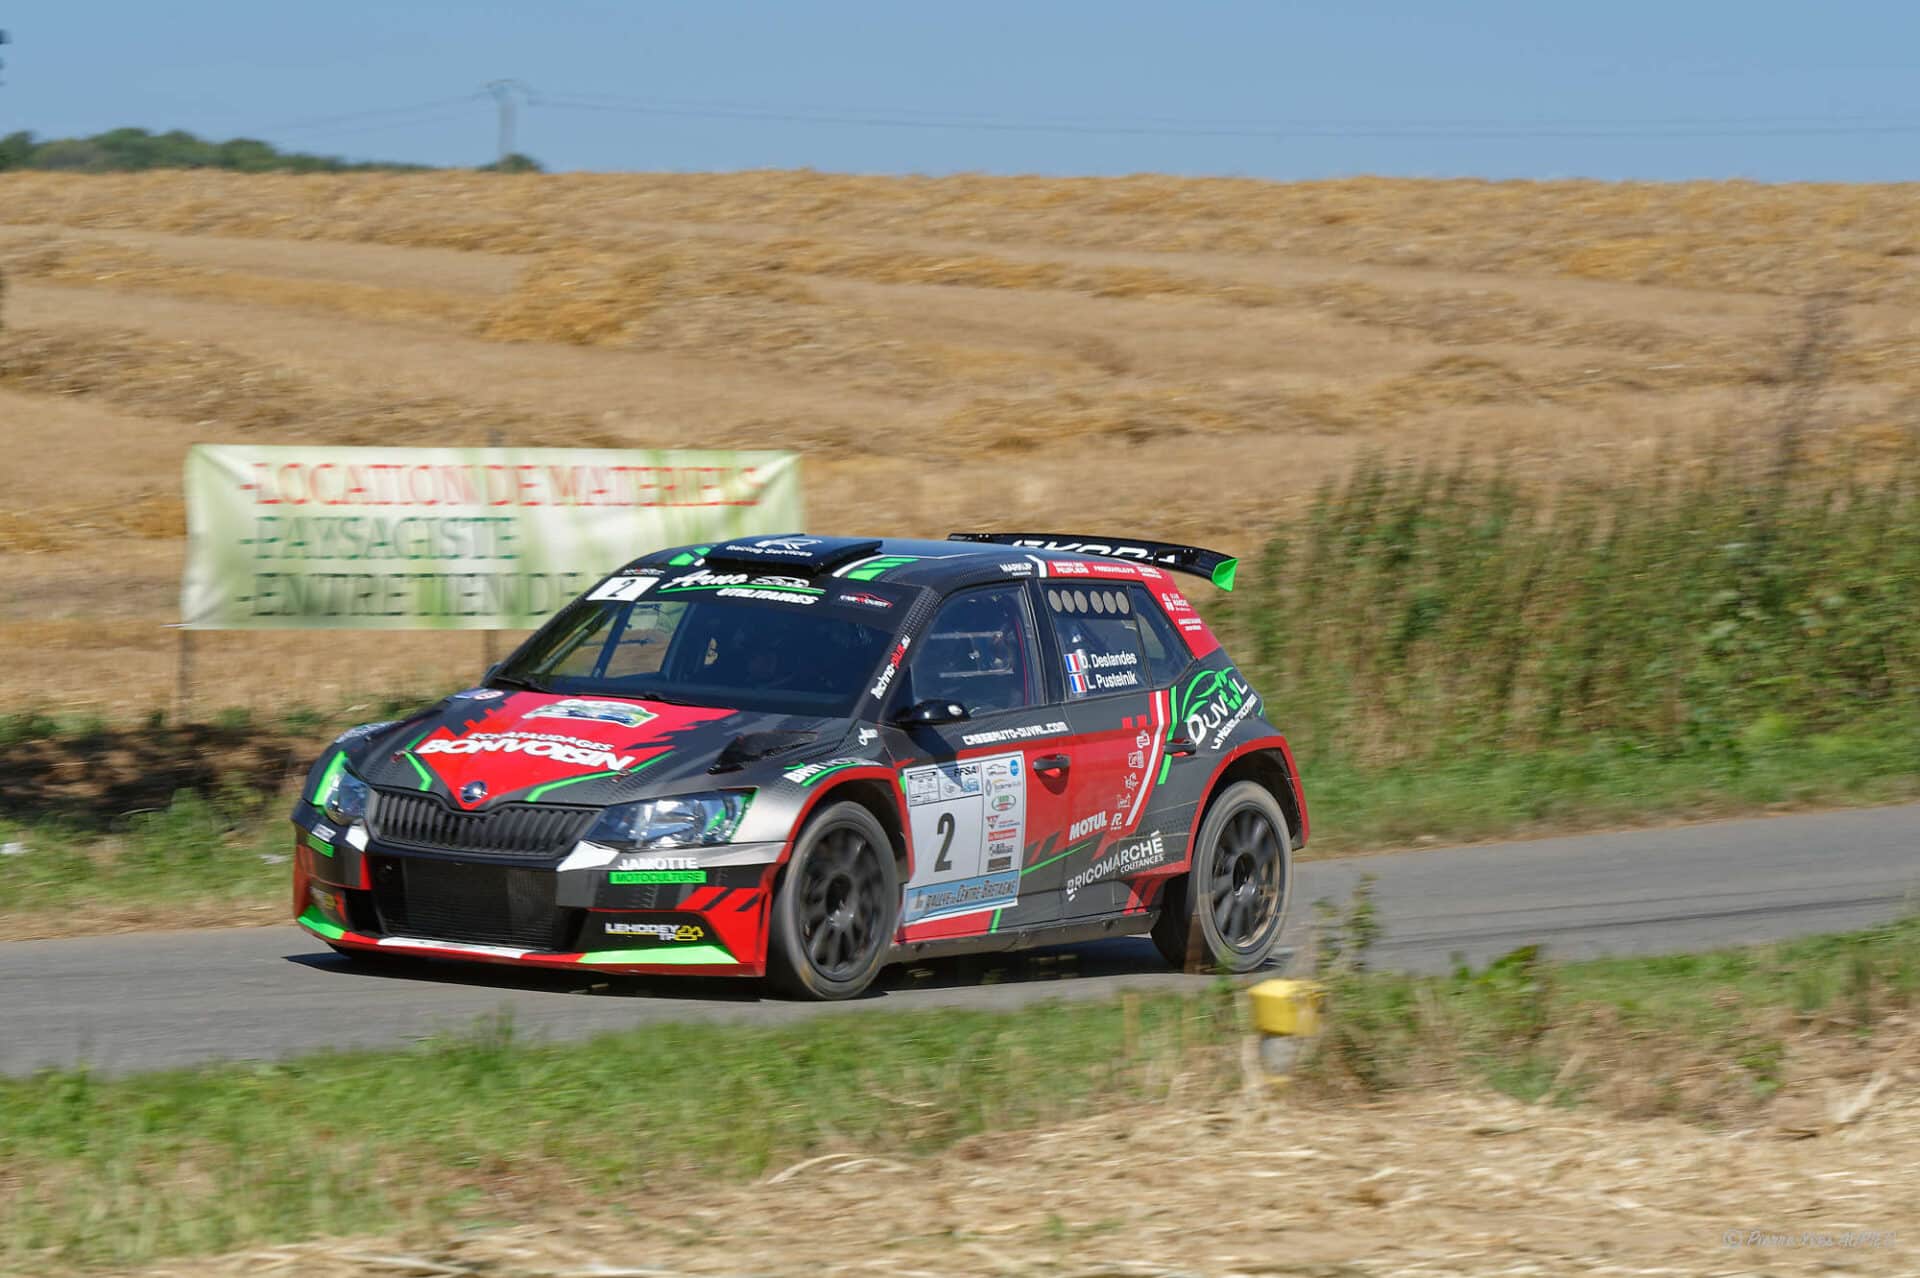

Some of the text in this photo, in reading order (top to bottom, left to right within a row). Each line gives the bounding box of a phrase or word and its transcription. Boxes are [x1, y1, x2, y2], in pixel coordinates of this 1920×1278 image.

[485, 463, 541, 507] DE
[607, 578, 637, 598] 2
[1092, 651, 1137, 668] Deslandes
[1087, 672, 1138, 690] L. Pustelnik
[415, 739, 635, 771] BONVOISIN
[1069, 811, 1108, 841] MOTUL
[934, 812, 956, 873] 2
[618, 857, 700, 870] JAMOTTE
[1066, 830, 1164, 895] BRICOMARCHÉ
[1120, 854, 1165, 873] COUTANCES
[615, 872, 702, 883] MOTOCULTURE
